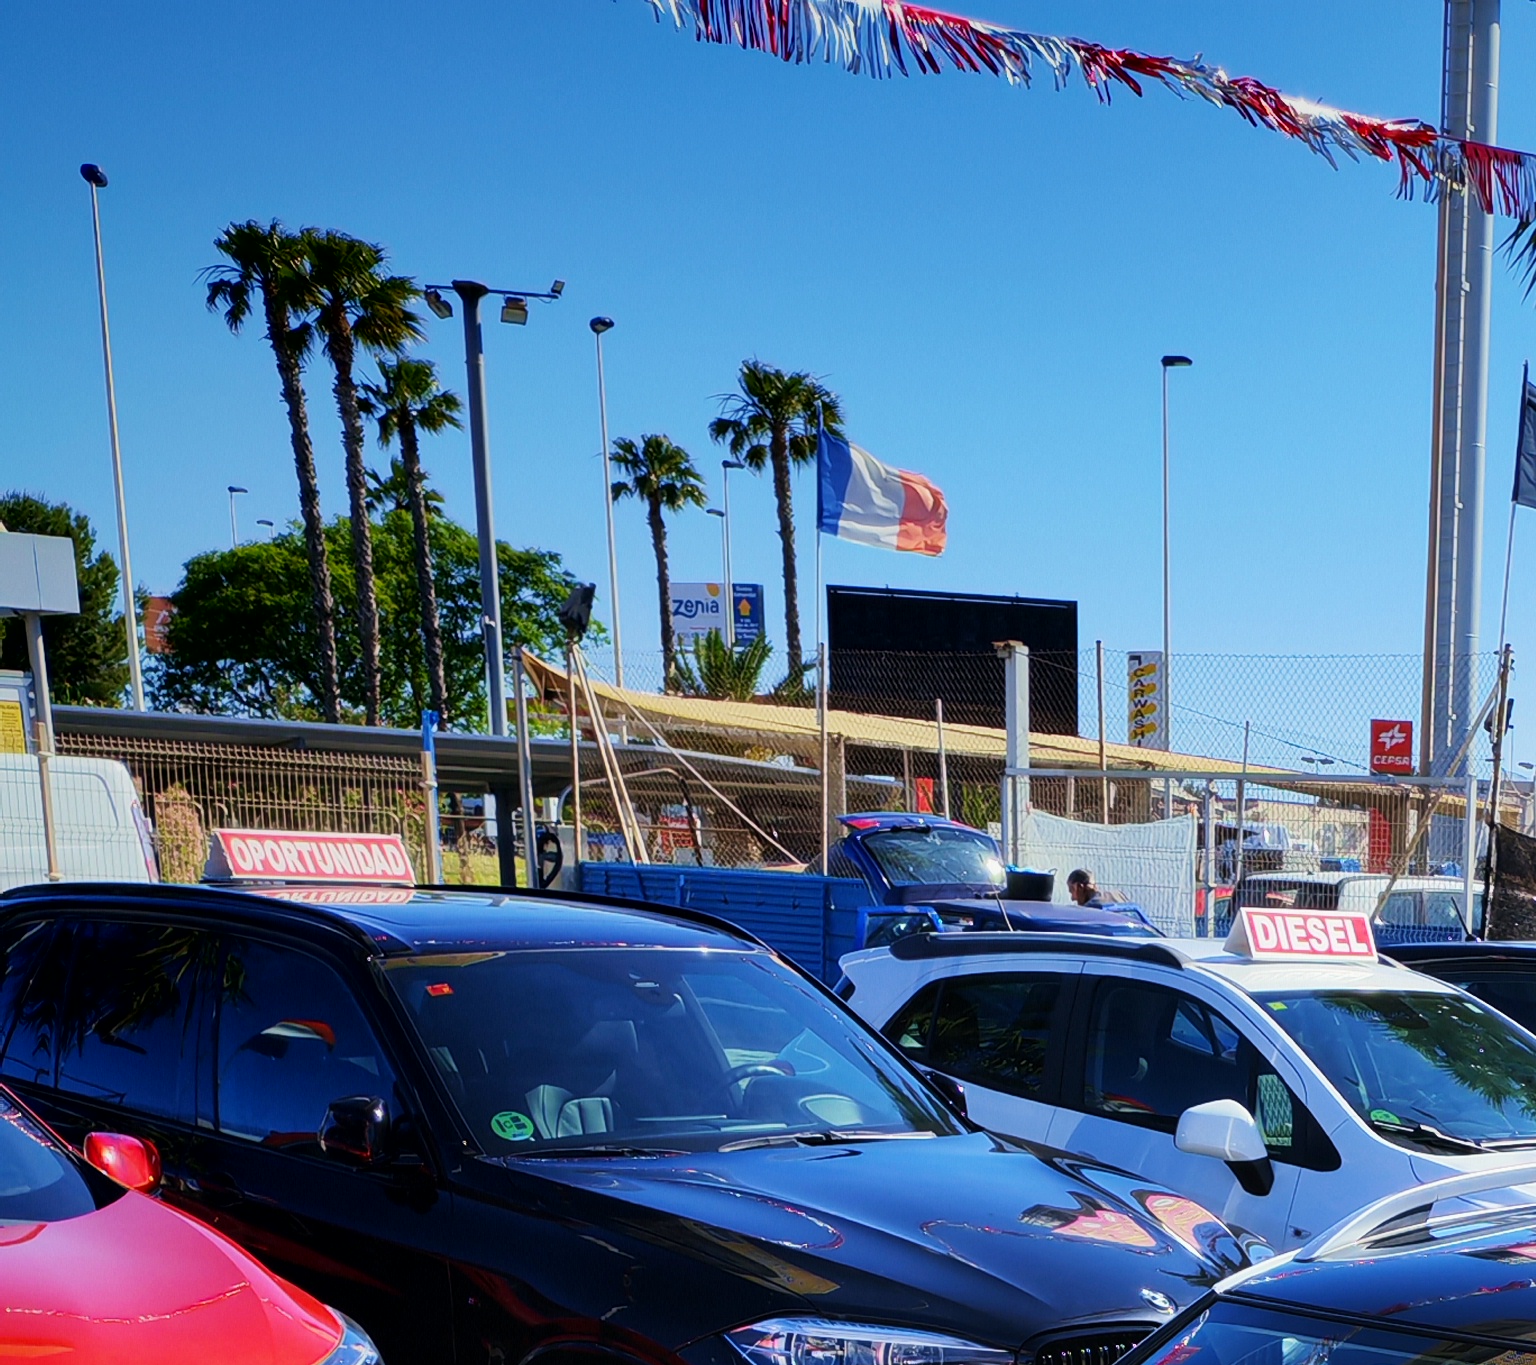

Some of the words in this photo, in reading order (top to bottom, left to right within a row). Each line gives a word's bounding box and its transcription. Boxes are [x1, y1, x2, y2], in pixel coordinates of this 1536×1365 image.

[1373, 754, 1410, 766] CEPSA
[230, 837, 406, 876] OPORTUNIDAD
[1251, 913, 1369, 953] DIESEL
